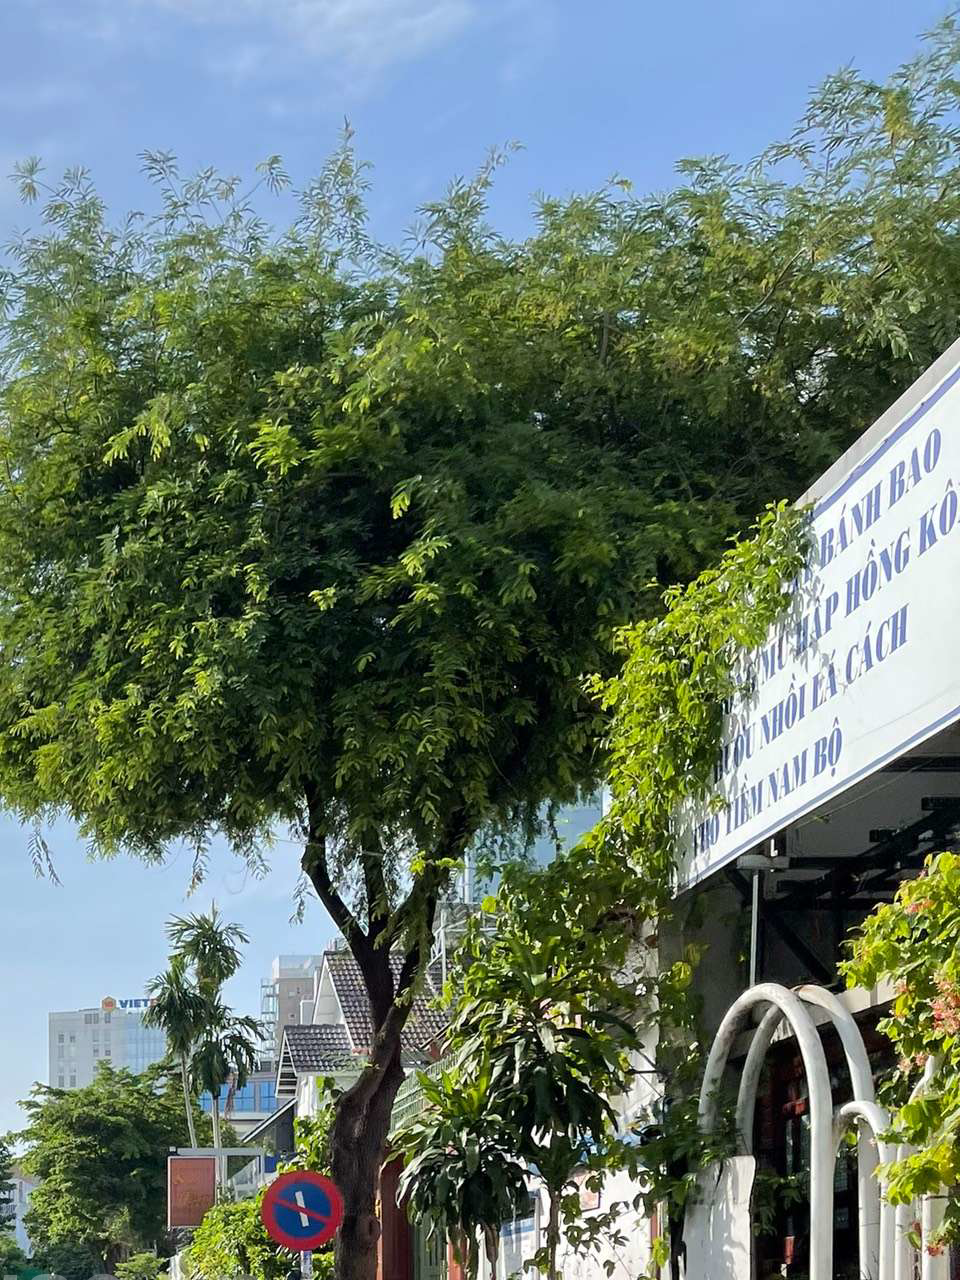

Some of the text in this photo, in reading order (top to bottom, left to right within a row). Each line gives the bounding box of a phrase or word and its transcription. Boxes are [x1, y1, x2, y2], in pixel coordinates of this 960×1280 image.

[819, 428, 941, 571] BÁNH BAO
[844, 528, 911, 618] HỒNG
[917, 478, 960, 558] KÔ
[760, 673, 807, 750] NHỒI
[846, 602, 910, 685] CÁCH
[767, 748, 809, 808] NAM
[813, 716, 843, 778] BỘ
